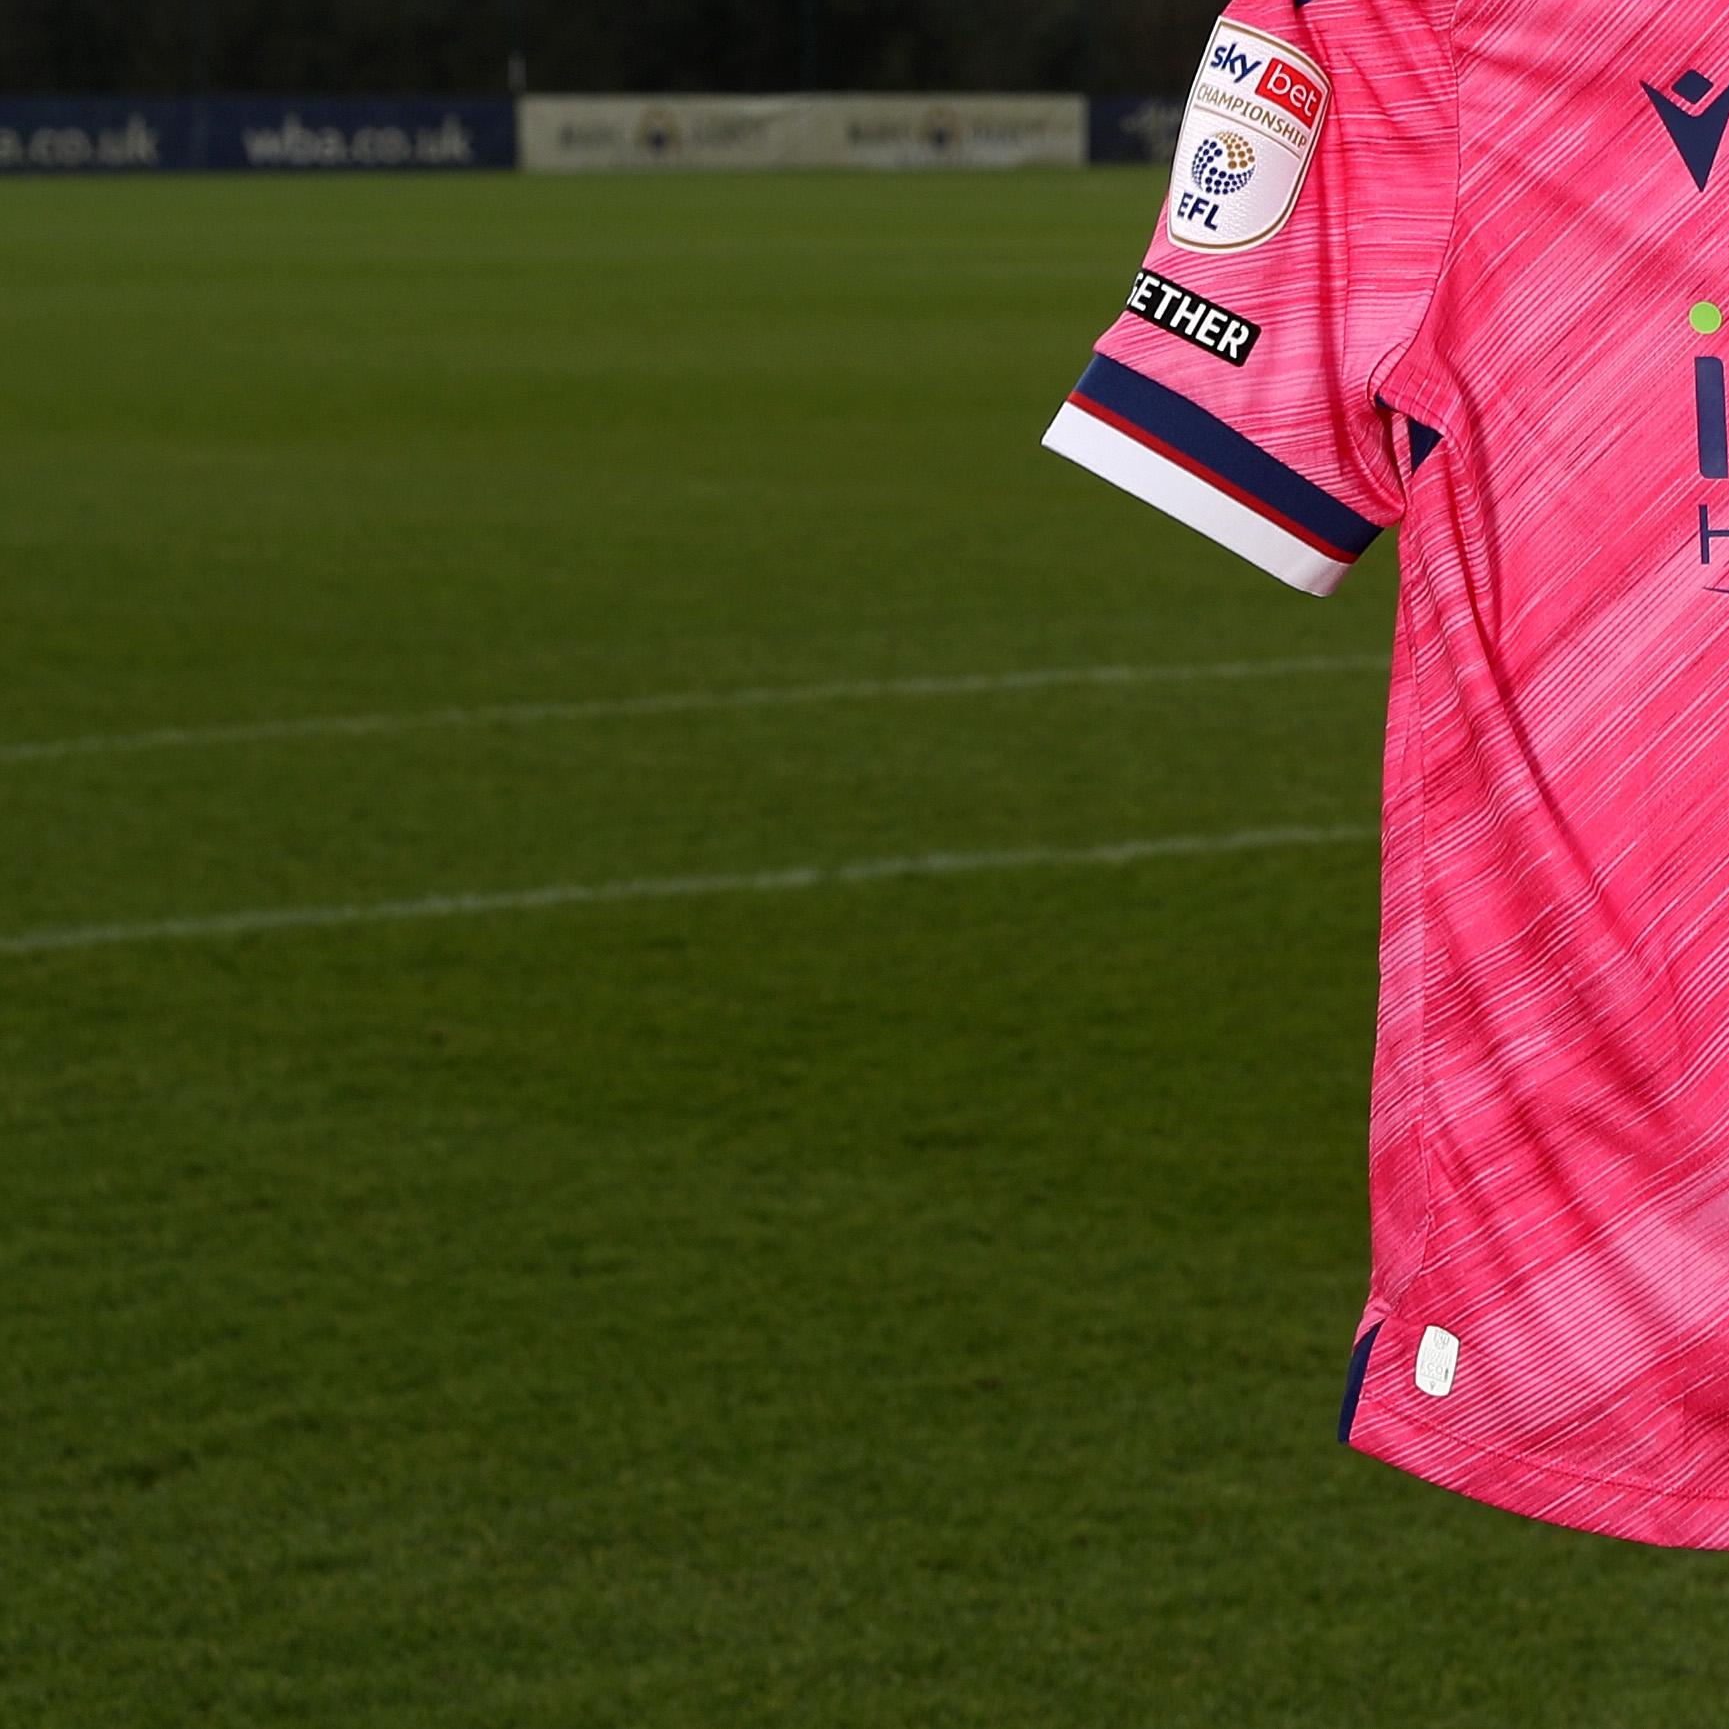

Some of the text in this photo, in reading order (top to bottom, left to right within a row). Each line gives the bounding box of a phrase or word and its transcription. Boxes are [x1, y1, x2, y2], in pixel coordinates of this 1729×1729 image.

[1210, 42, 1318, 117] sky bet
[1198, 84, 1308, 147] CHAMPIONSHIP
[1177, 192, 1221, 232] EFL
